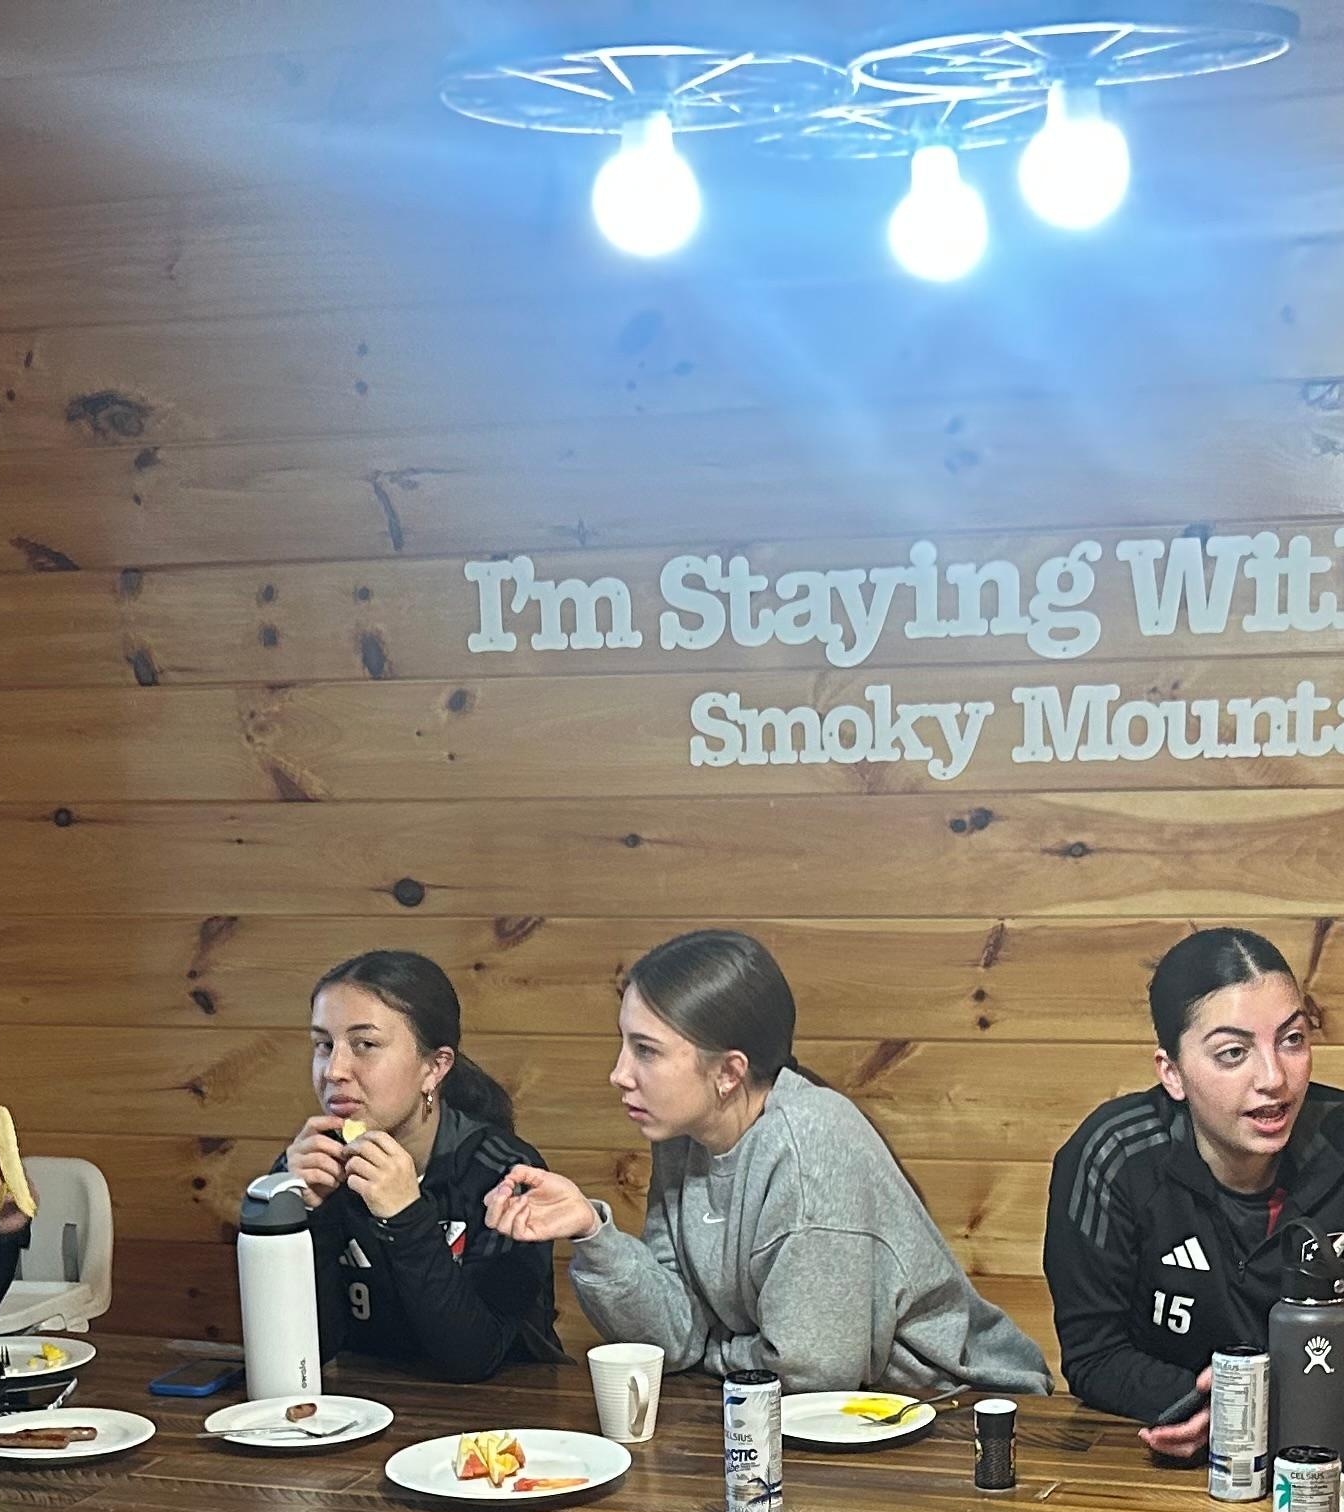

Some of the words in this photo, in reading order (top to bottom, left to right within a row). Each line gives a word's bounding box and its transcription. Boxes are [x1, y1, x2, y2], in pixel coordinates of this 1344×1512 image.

[464, 555, 643, 653] I'm
[659, 540, 1103, 668] Staying
[689, 684, 995, 781] Smoky
[349, 1282, 371, 1320] 9
[1152, 1290, 1195, 1335] 15
